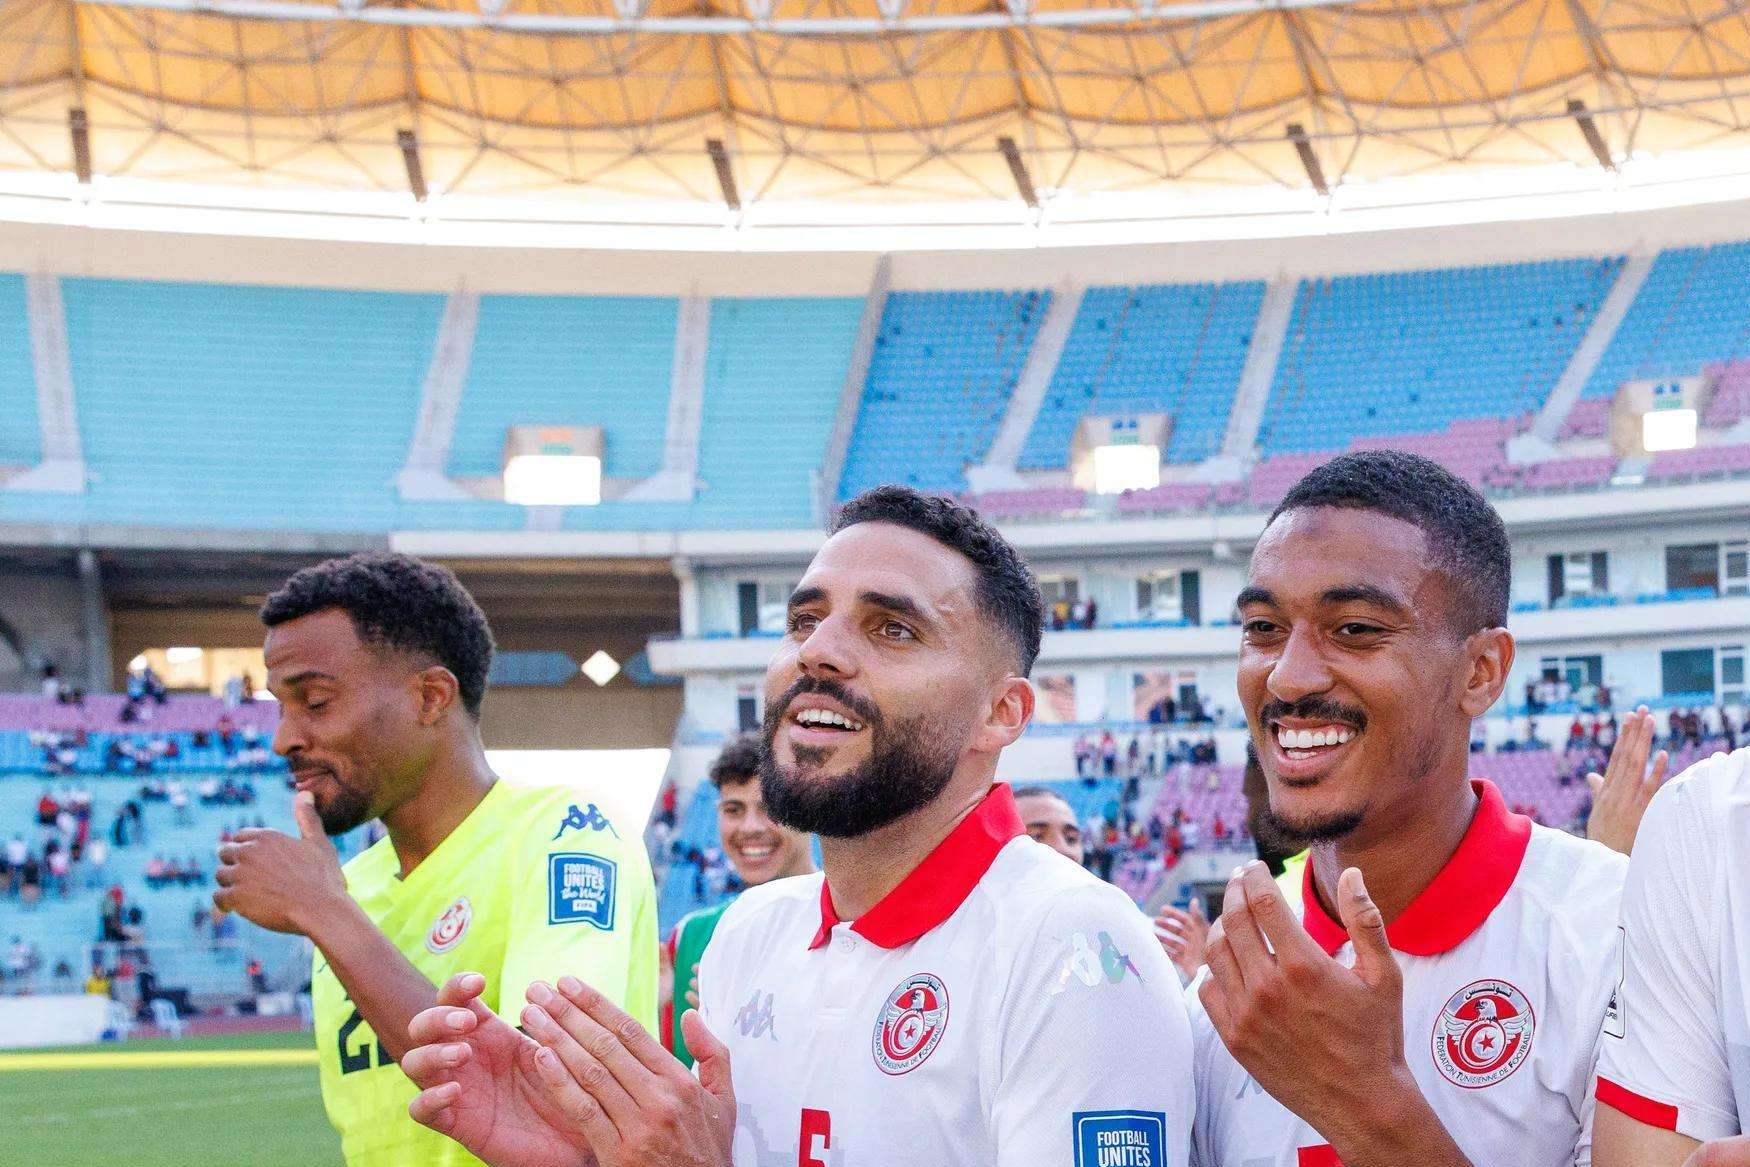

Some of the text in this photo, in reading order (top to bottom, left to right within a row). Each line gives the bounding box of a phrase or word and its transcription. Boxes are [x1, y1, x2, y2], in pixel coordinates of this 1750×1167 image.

[1465, 983, 1514, 1000] تونس
[338, 995, 395, 1075] 2
[1436, 1033, 1531, 1084] FEDERATION TUNISIENNE DE FOOTBALL
[1097, 1130, 1150, 1147] FOOTBALL
[1098, 1146, 1151, 1167] UNITES
